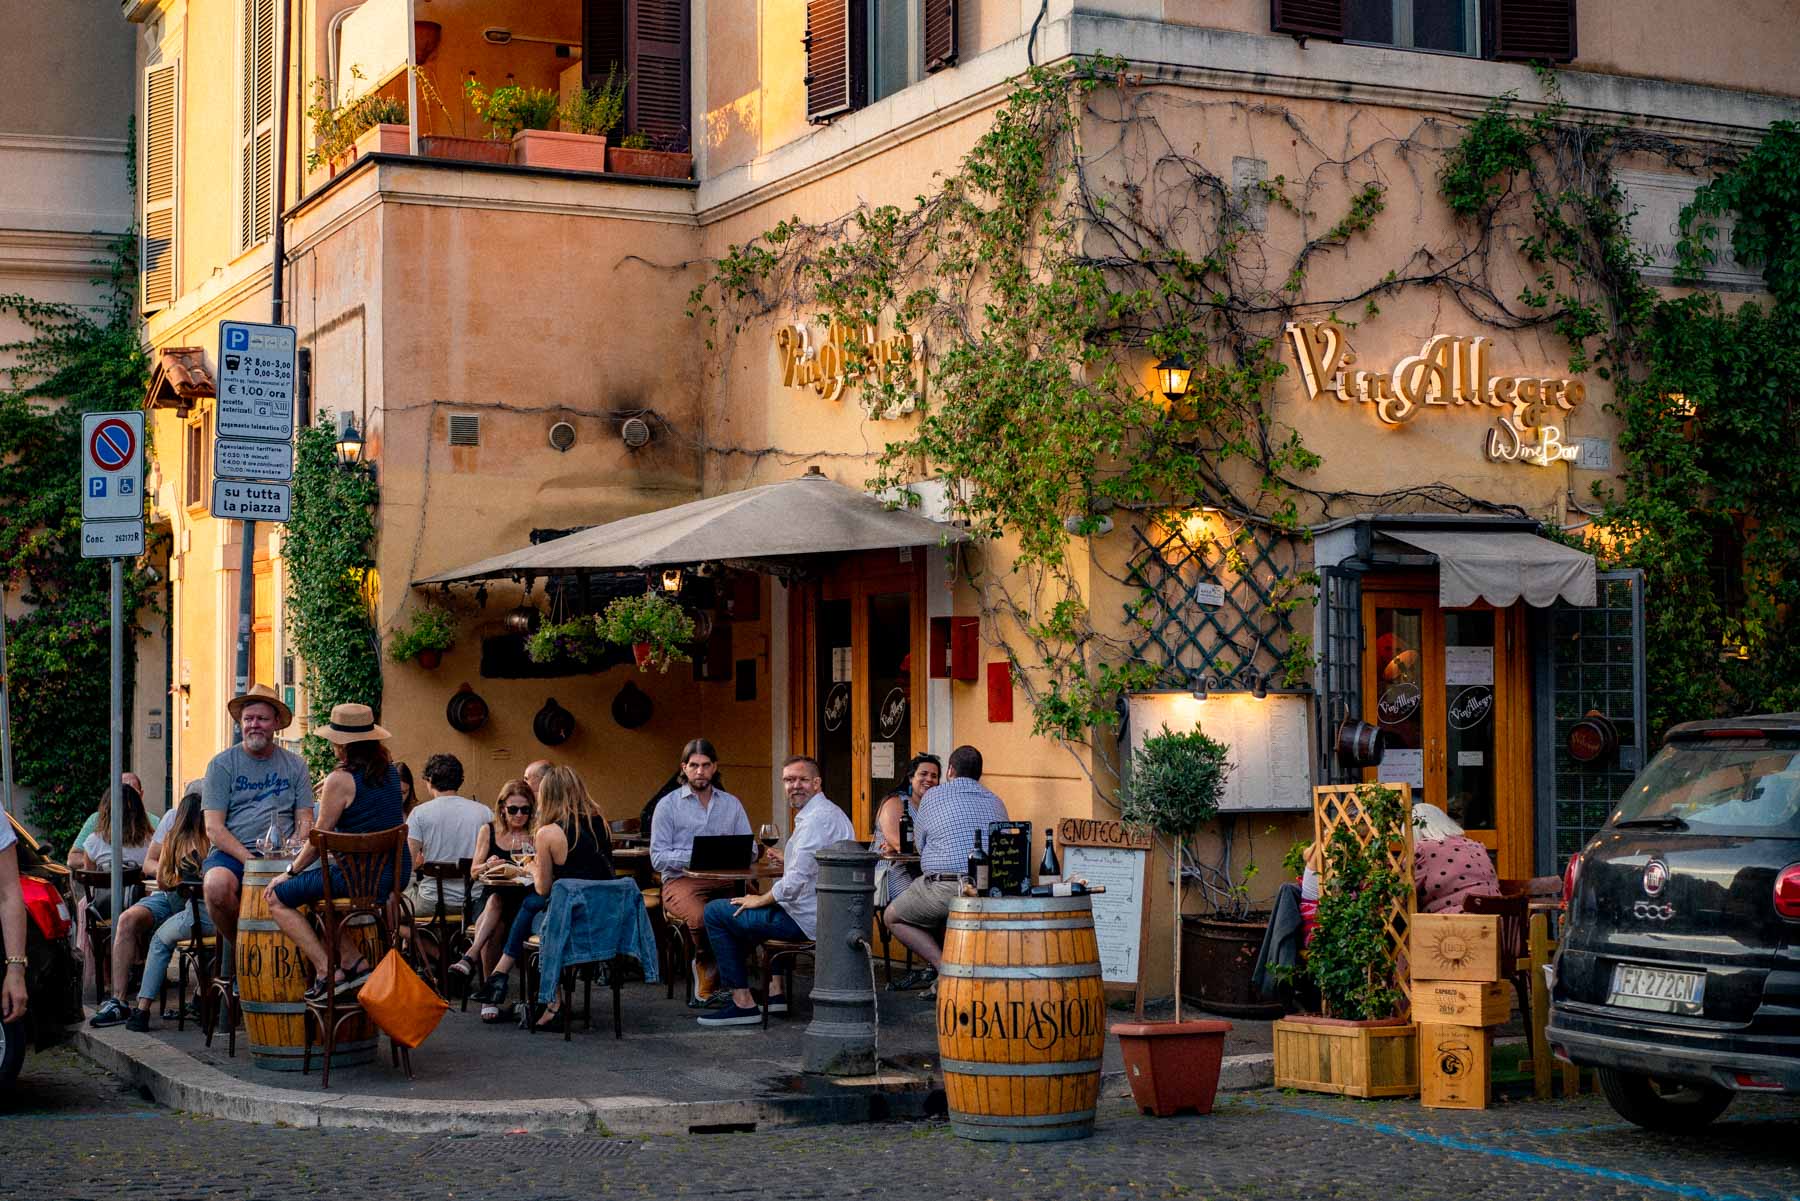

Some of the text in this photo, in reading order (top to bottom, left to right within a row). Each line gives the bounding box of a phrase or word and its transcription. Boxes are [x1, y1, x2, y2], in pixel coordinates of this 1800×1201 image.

[224, 488, 280, 500] su tutta
[224, 499, 280, 514] la piazza
[235, 772, 289, 797] Brooklyn
